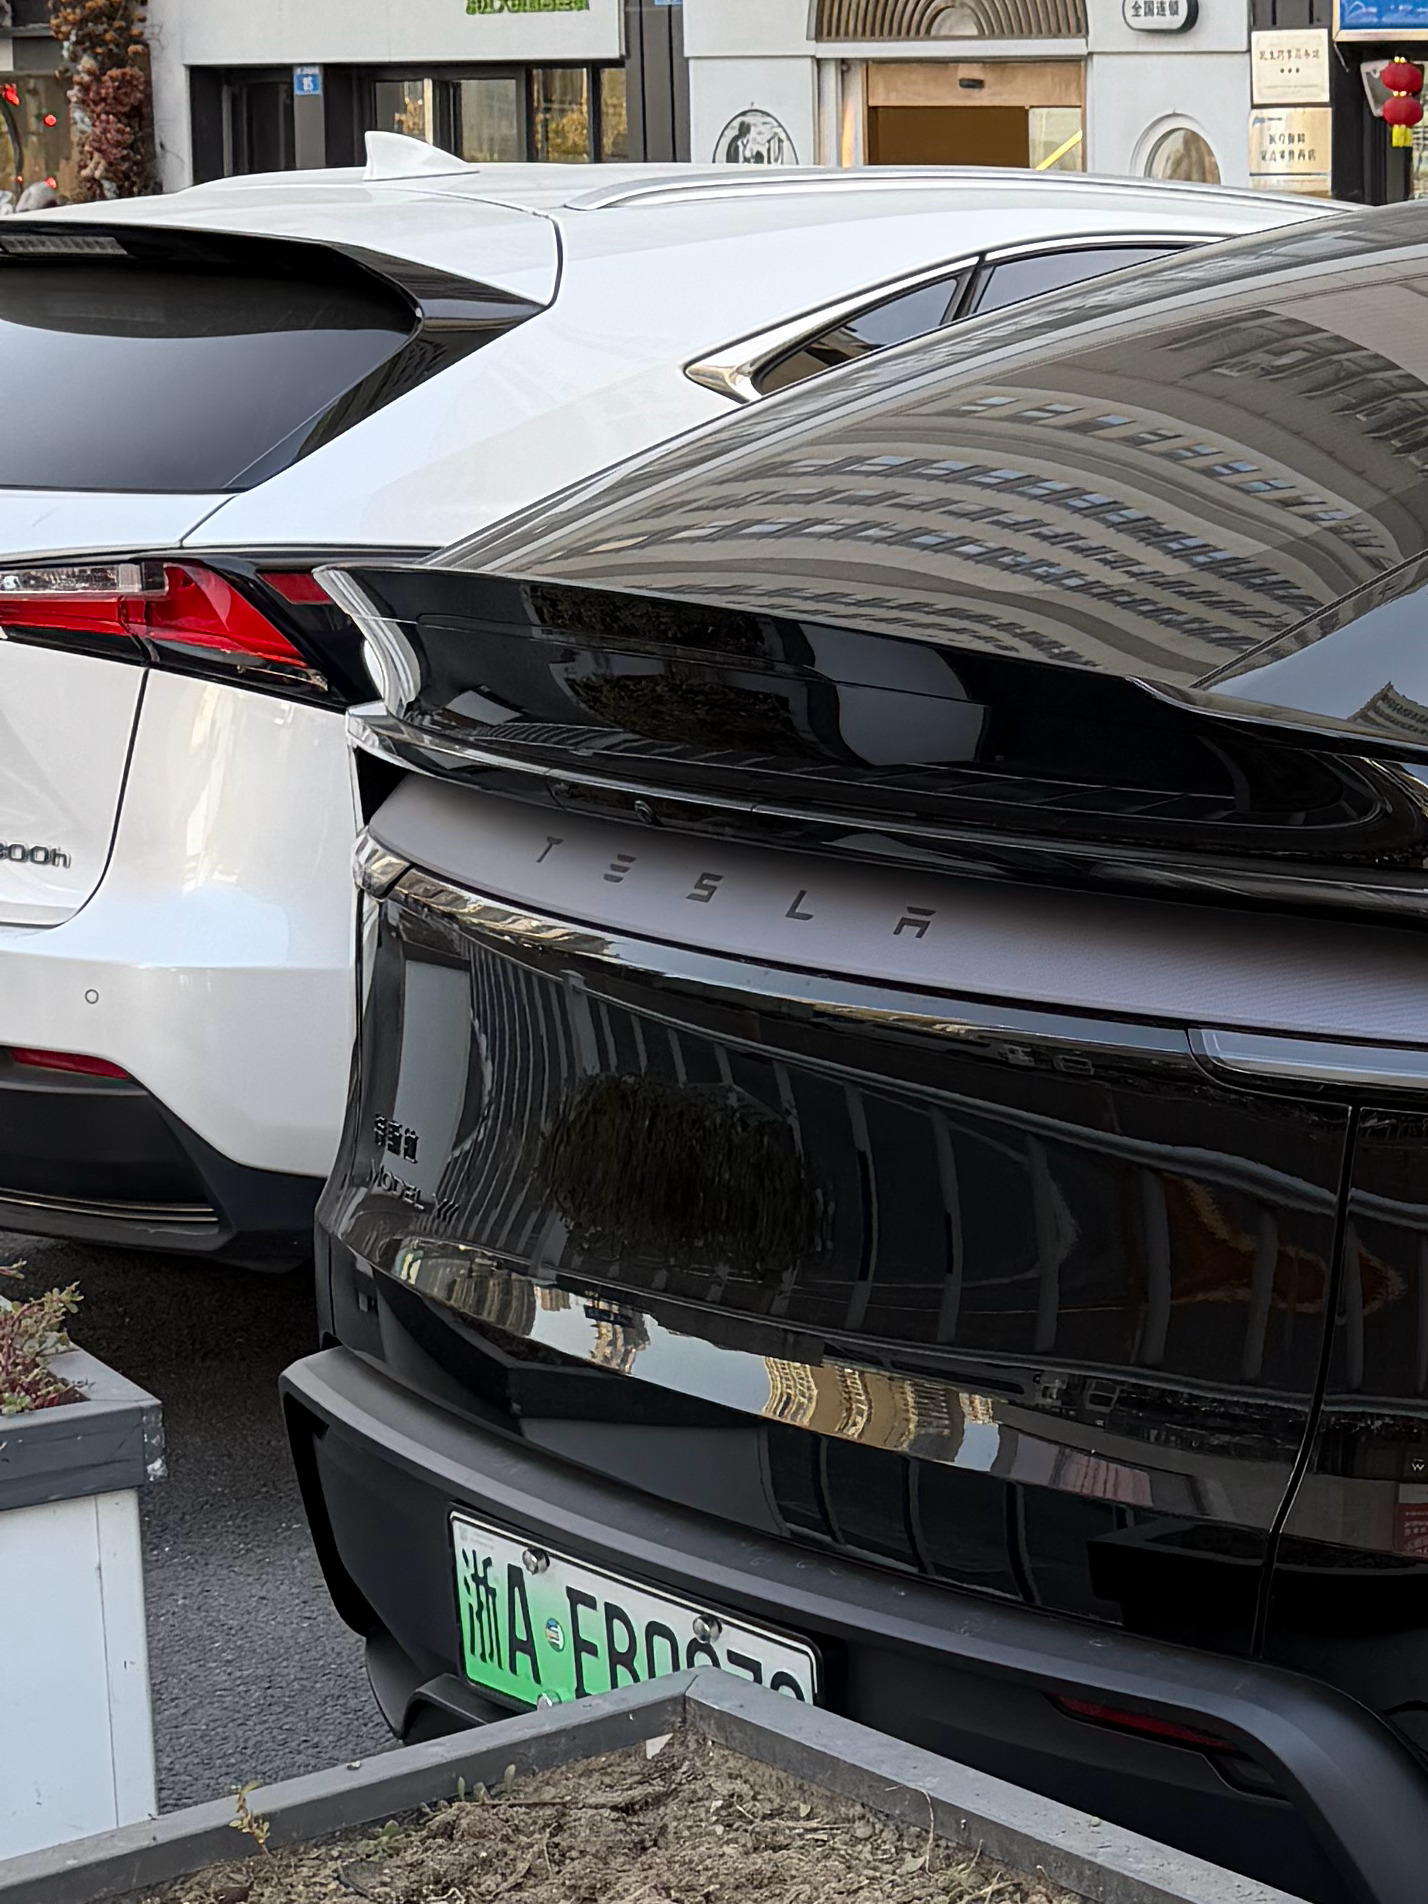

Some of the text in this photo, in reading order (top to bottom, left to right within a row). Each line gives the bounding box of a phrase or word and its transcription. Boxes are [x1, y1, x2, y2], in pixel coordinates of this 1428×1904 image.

[1132, 0, 1180, 18] 全国连锁
[535, 835, 938, 941] TESLA
